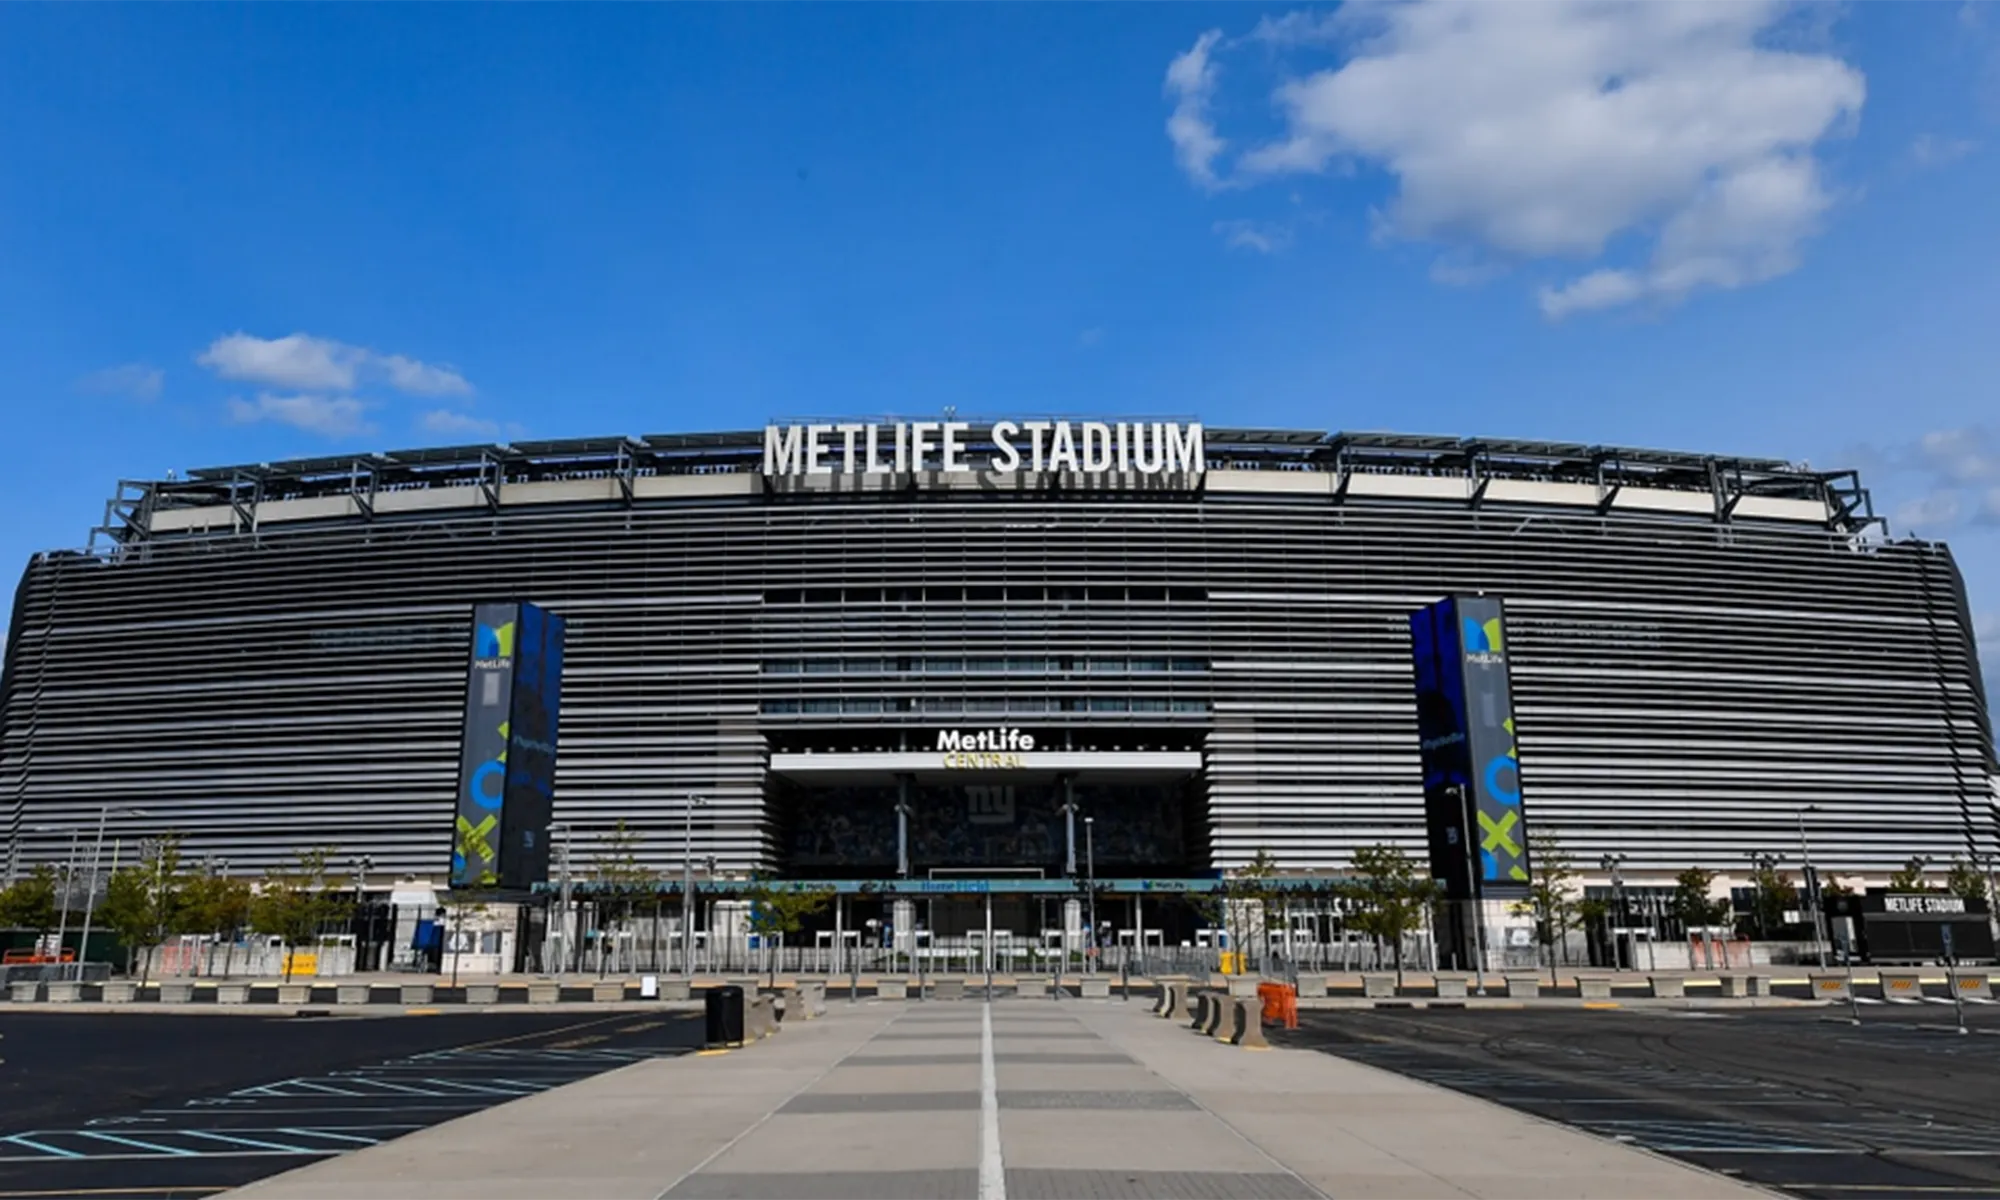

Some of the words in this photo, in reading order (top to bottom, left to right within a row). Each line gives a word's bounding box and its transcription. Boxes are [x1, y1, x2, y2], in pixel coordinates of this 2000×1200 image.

[763, 422, 970, 476] METLIFE
[991, 421, 1206, 474] STADIUM
[937, 727, 1035, 751] MetLife
[943, 751, 1027, 769] CENTRAL
[1884, 896, 1925, 913] METLIFE
[1925, 897, 1966, 914] STADIUM
